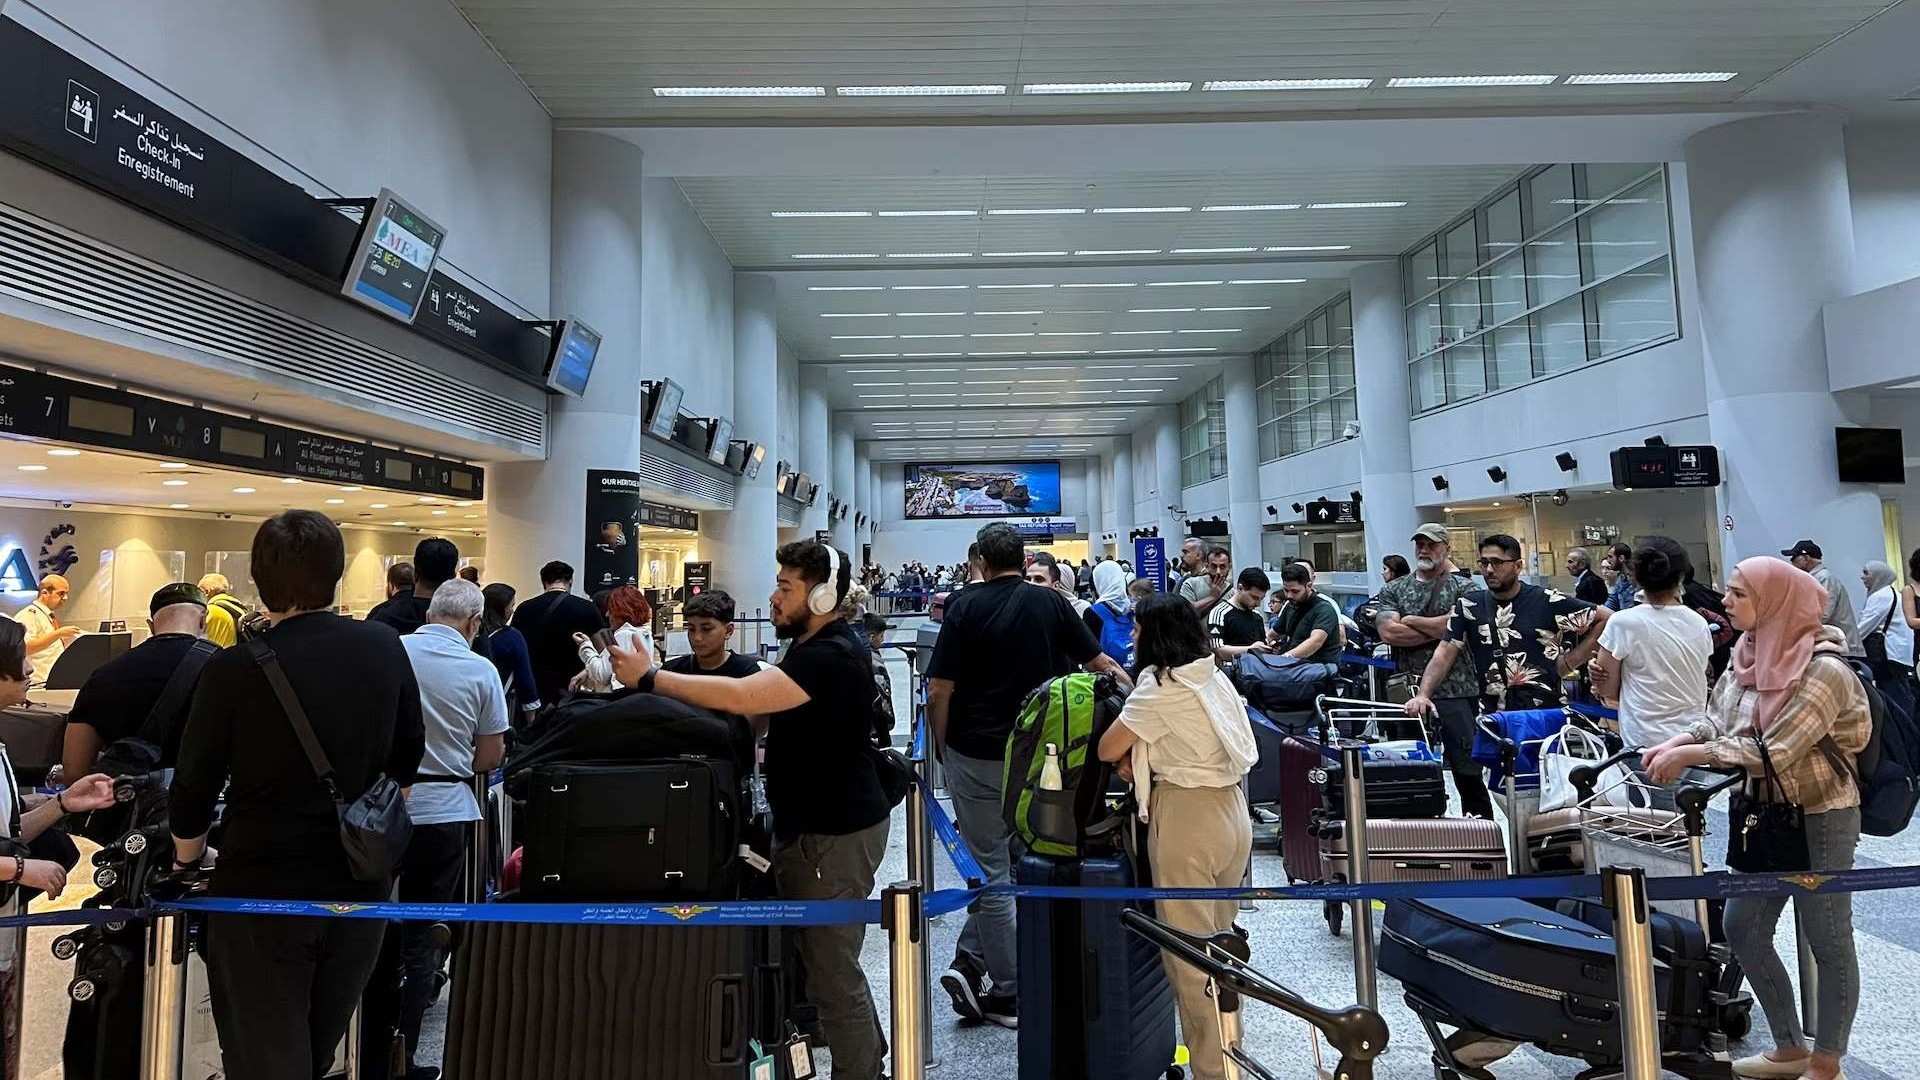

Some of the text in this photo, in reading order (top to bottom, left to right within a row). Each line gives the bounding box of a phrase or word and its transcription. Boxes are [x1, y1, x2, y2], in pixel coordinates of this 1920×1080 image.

[112, 104, 204, 161] تسجيل تذاكر السفر
[137, 134, 181, 170] Check-In
[117, 147, 195, 199] Enregistrement
[44, 396, 54, 417] 7
[203, 427, 211, 444] 8
[375, 460, 380, 473] 9
[601, 478, 616, 486] OUR
